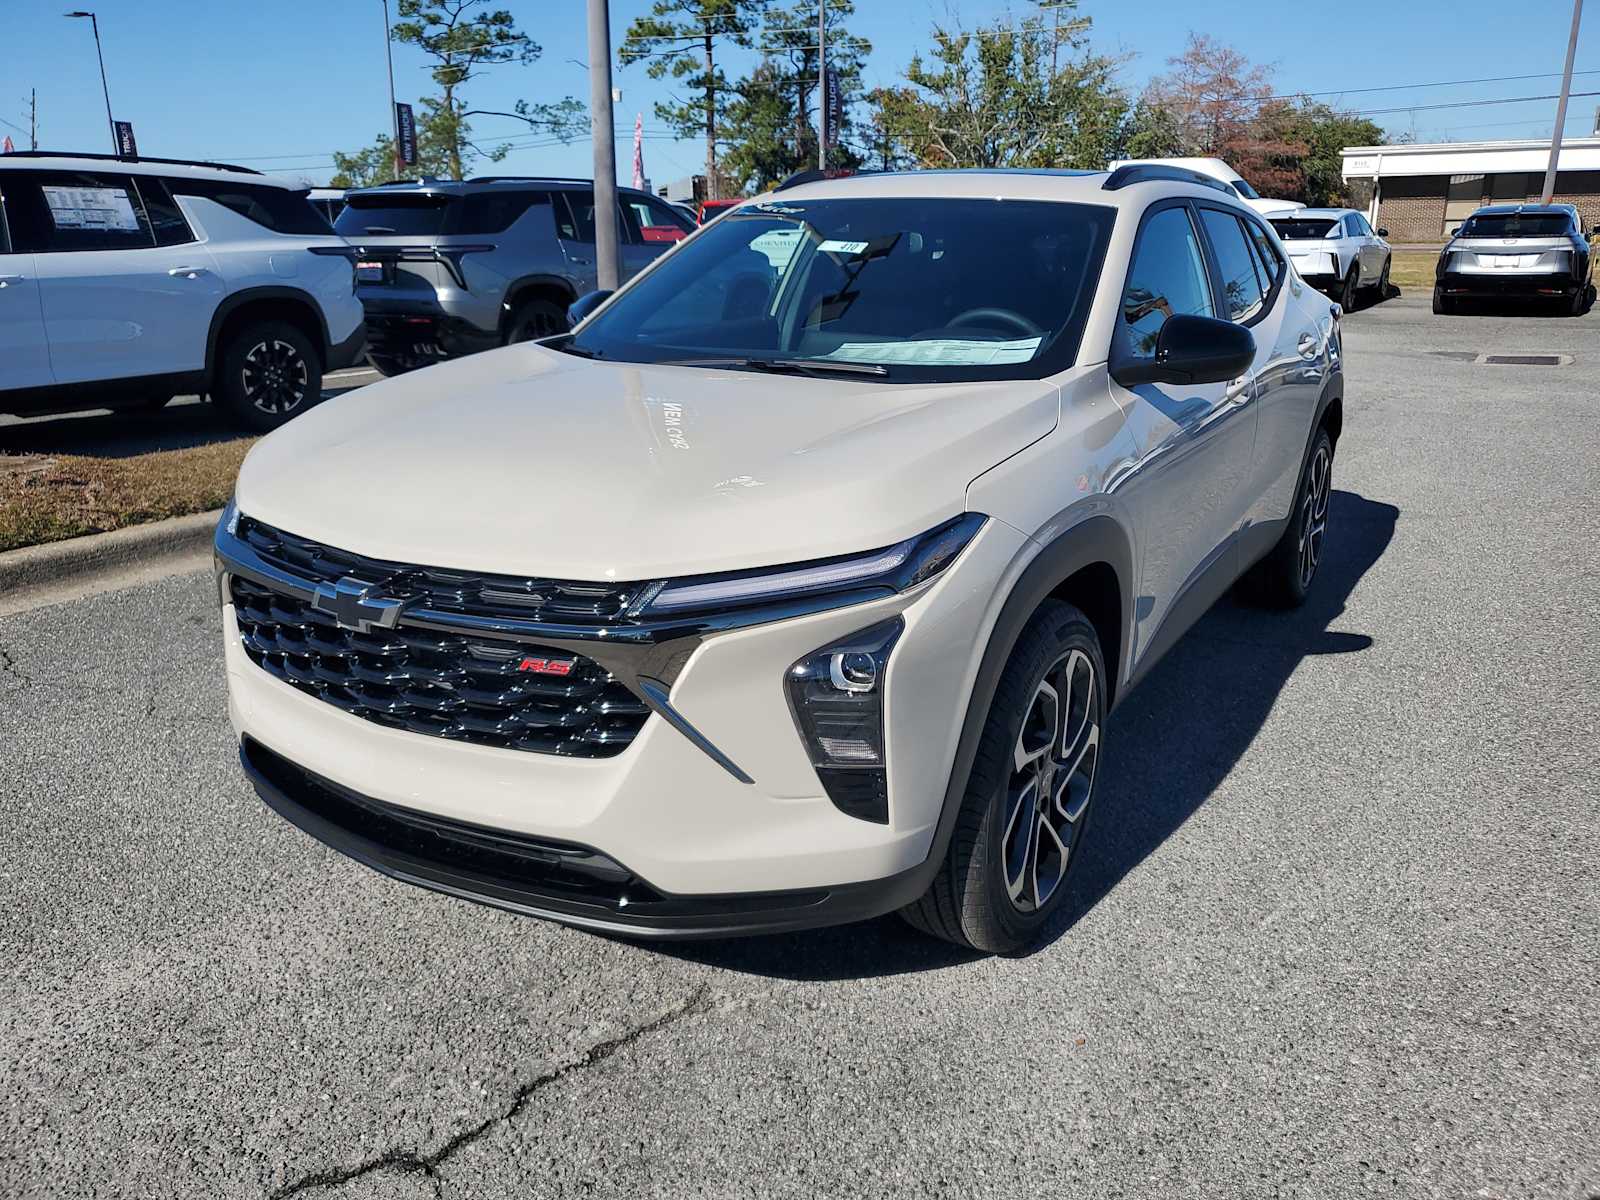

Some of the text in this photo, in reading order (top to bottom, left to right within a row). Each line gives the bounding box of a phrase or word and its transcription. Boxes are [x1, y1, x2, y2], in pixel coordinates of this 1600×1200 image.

[828, 72, 838, 115] TRUCKS
[120, 123, 132, 154] TRUCKS
[519, 657, 570, 676] RS
